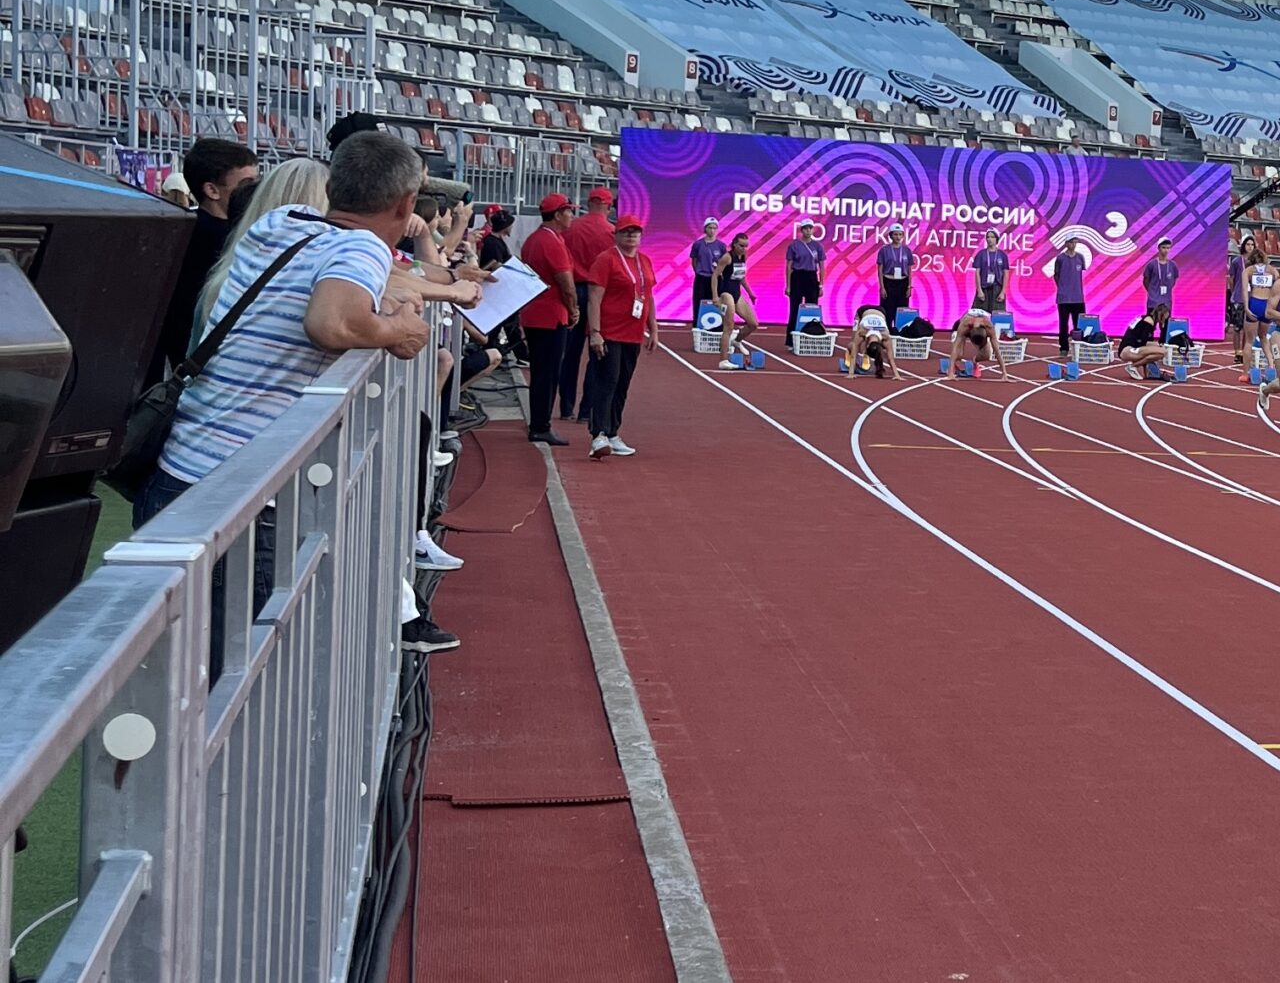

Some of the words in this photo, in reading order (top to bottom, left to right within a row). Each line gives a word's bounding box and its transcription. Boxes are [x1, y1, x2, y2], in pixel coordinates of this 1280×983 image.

[629, 56, 637, 68] 9
[688, 62, 696, 74] 8
[734, 192, 783, 212] ПСБ
[790, 196, 935, 219] ЧЕМПИОНАТ
[941, 203, 1035, 226] РОССИИ
[832, 223, 920, 246] ЛЕГКЙ
[952, 256, 1033, 277] КАНЬ
